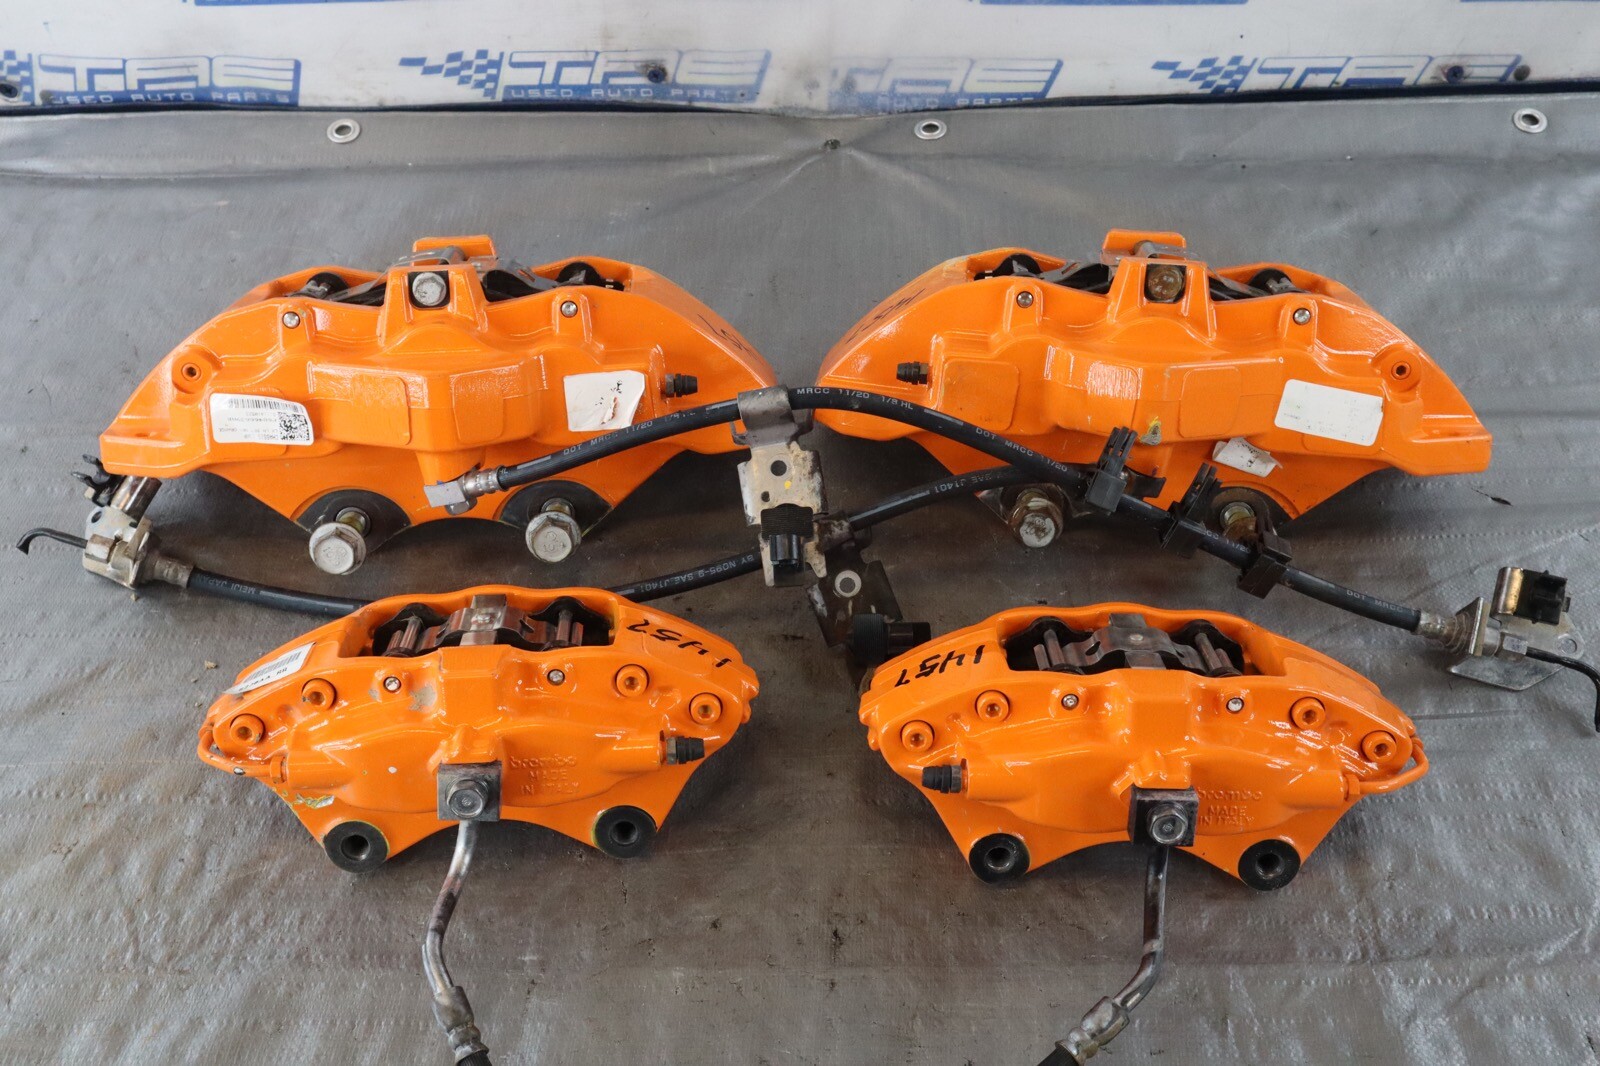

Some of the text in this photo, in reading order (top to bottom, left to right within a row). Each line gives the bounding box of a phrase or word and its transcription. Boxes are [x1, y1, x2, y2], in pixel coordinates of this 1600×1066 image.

[130, 92, 195, 102] AUTO
[511, 88, 573, 98] USED
[591, 87, 654, 98] AUTO
[796, 387, 914, 410] MRCC 11/20 1/8 HL
[563, 444, 583, 456] DOT
[625, 420, 654, 435] 11/20
[975, 426, 997, 440] DOT
[1004, 440, 1035, 457] MRCC
[741, 554, 756, 565] BY
[674, 572, 694, 585] SAE
[230, 582, 257, 595] MEIJI
[639, 579, 669, 593] J1401
[1346, 588, 1367, 601] DOT
[1374, 598, 1403, 614] MRCC
[894, 645, 985, 688] 1457
[1197, 786, 1263, 801] brembo
[1207, 804, 1247, 816] MADE
[1198, 815, 1255, 826] IN ITALY
